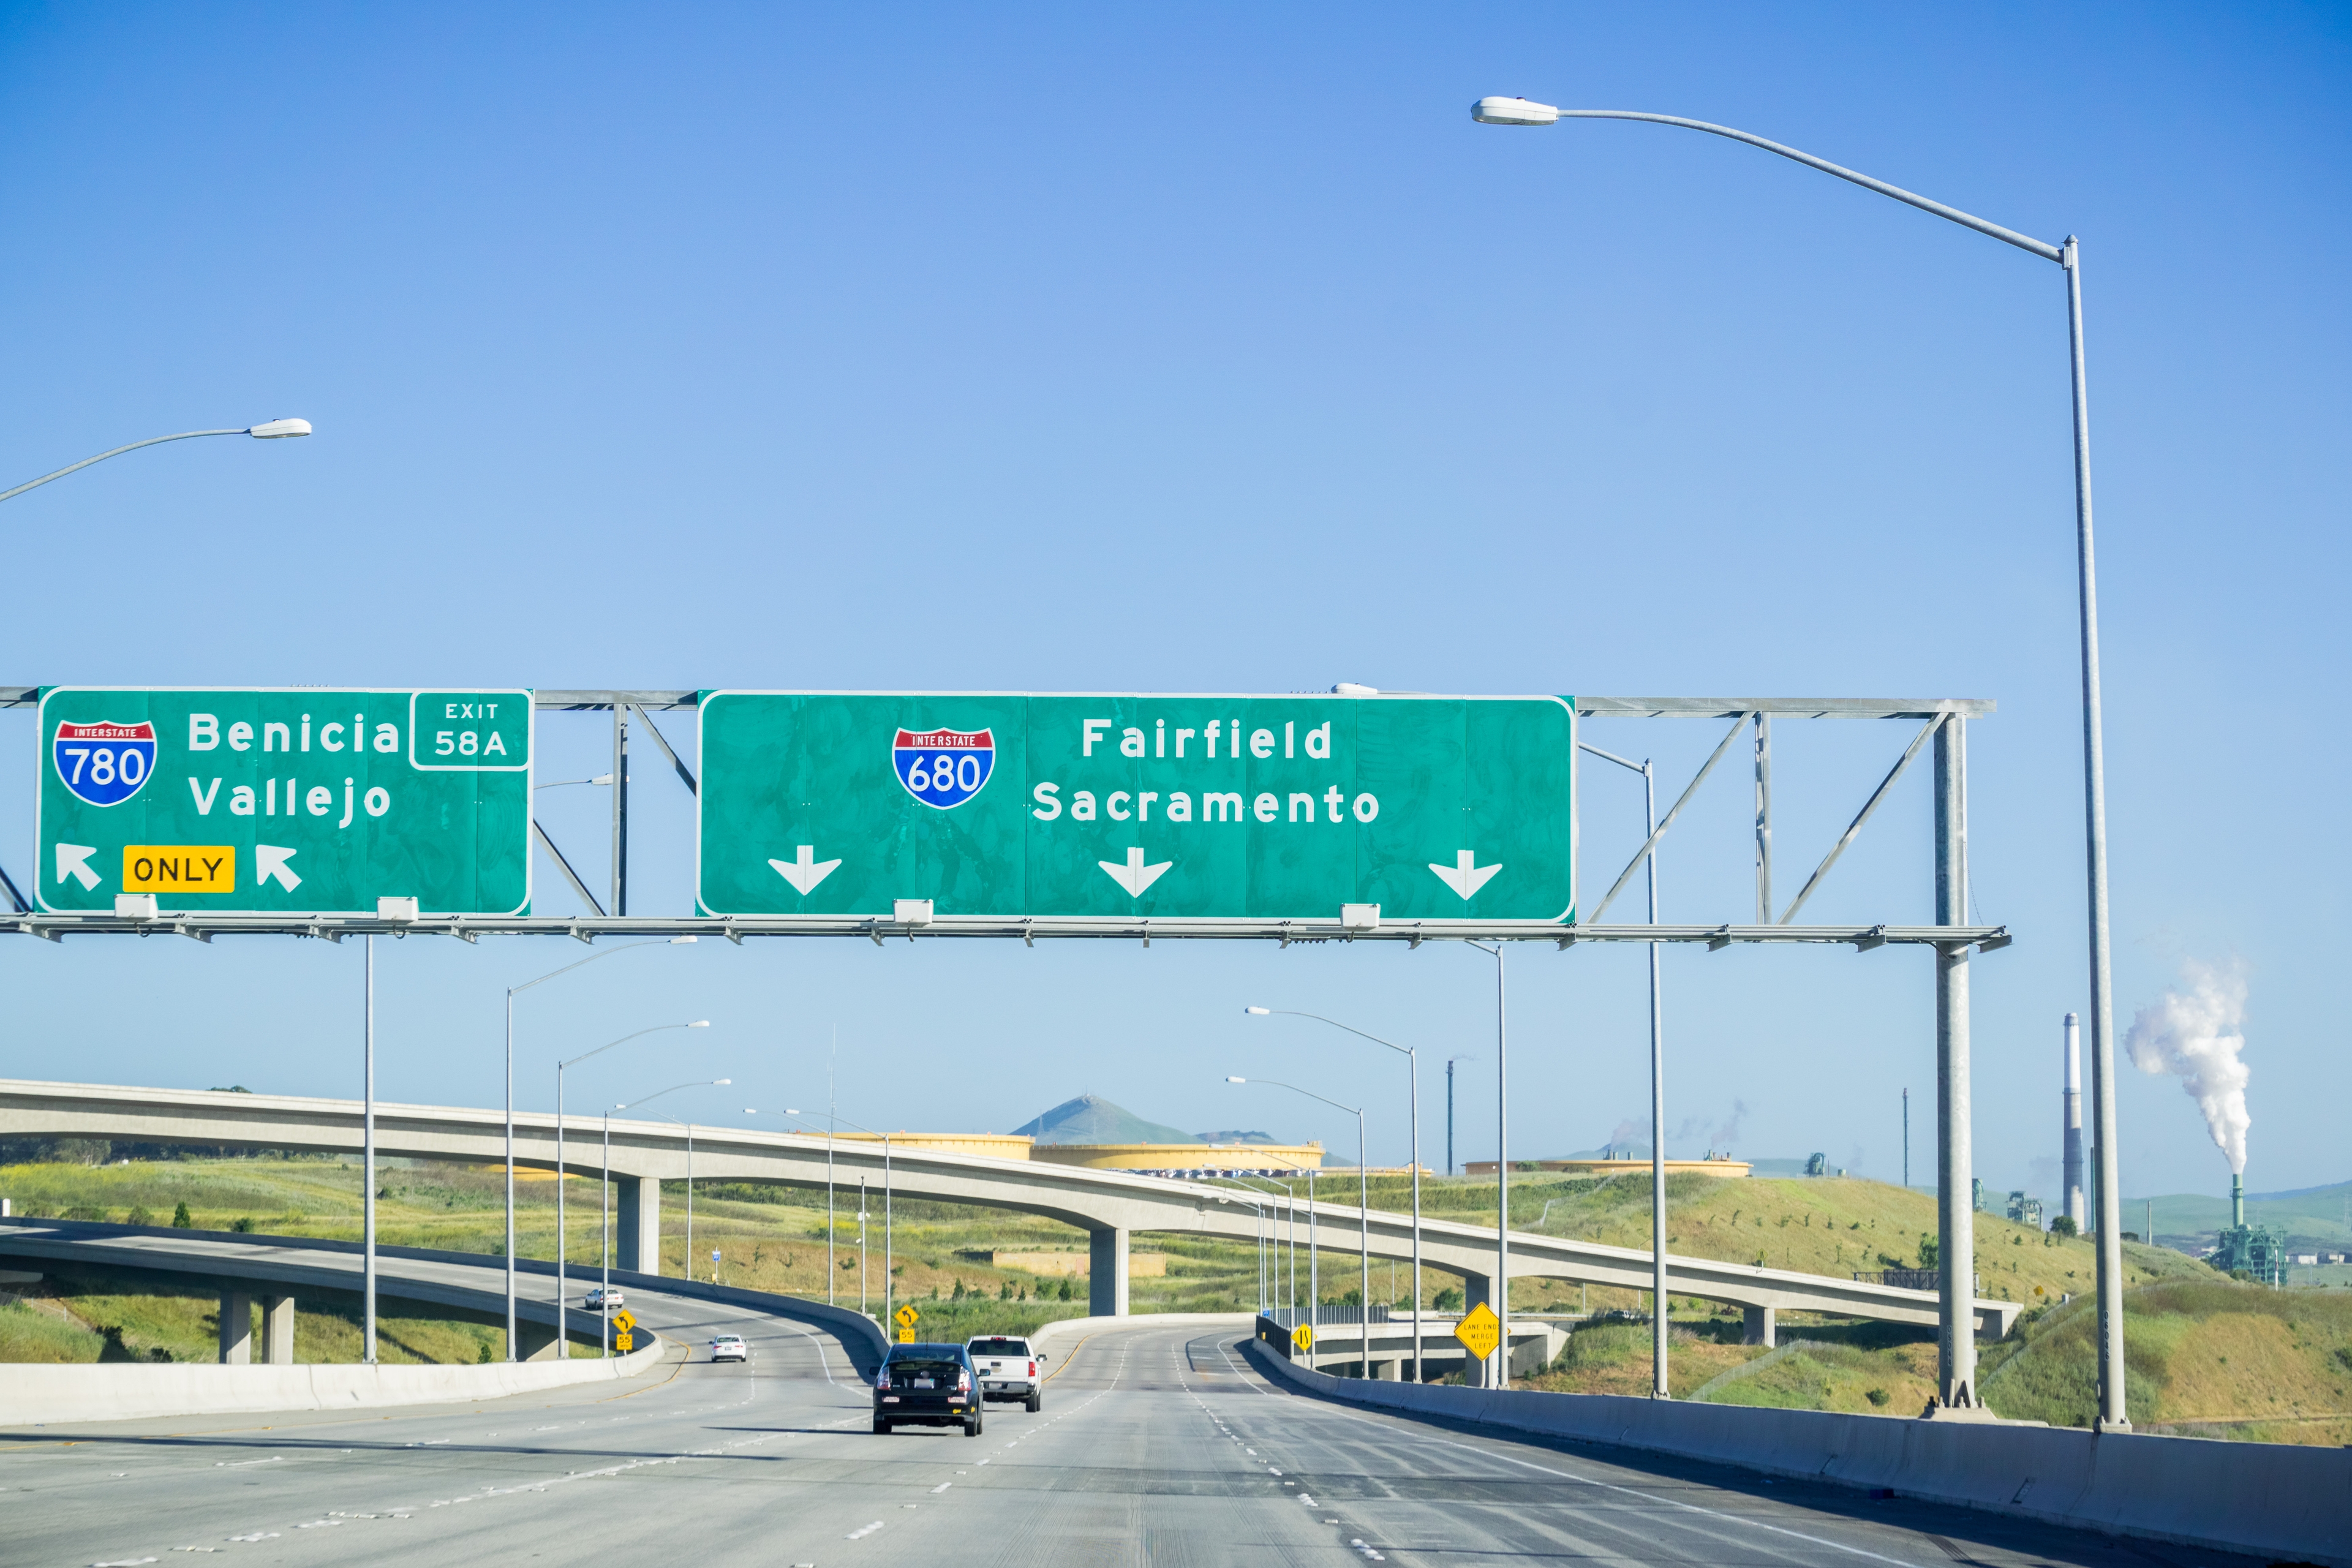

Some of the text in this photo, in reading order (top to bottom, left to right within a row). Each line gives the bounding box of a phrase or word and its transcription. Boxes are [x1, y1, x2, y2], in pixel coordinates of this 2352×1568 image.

[447, 704, 497, 719] EXIT
[74, 728, 137, 737] INTERSTATE
[189, 714, 399, 753] Benicia
[435, 731, 507, 756] 58A
[911, 736, 976, 747] INTERSTATE
[1083, 718, 1330, 759] Fairfield
[65, 748, 145, 786] 780
[908, 755, 981, 793] 680
[188, 777, 390, 829] Vallejo
[1031, 782, 1379, 823] Sacramento
[134, 858, 224, 881] ONLY
